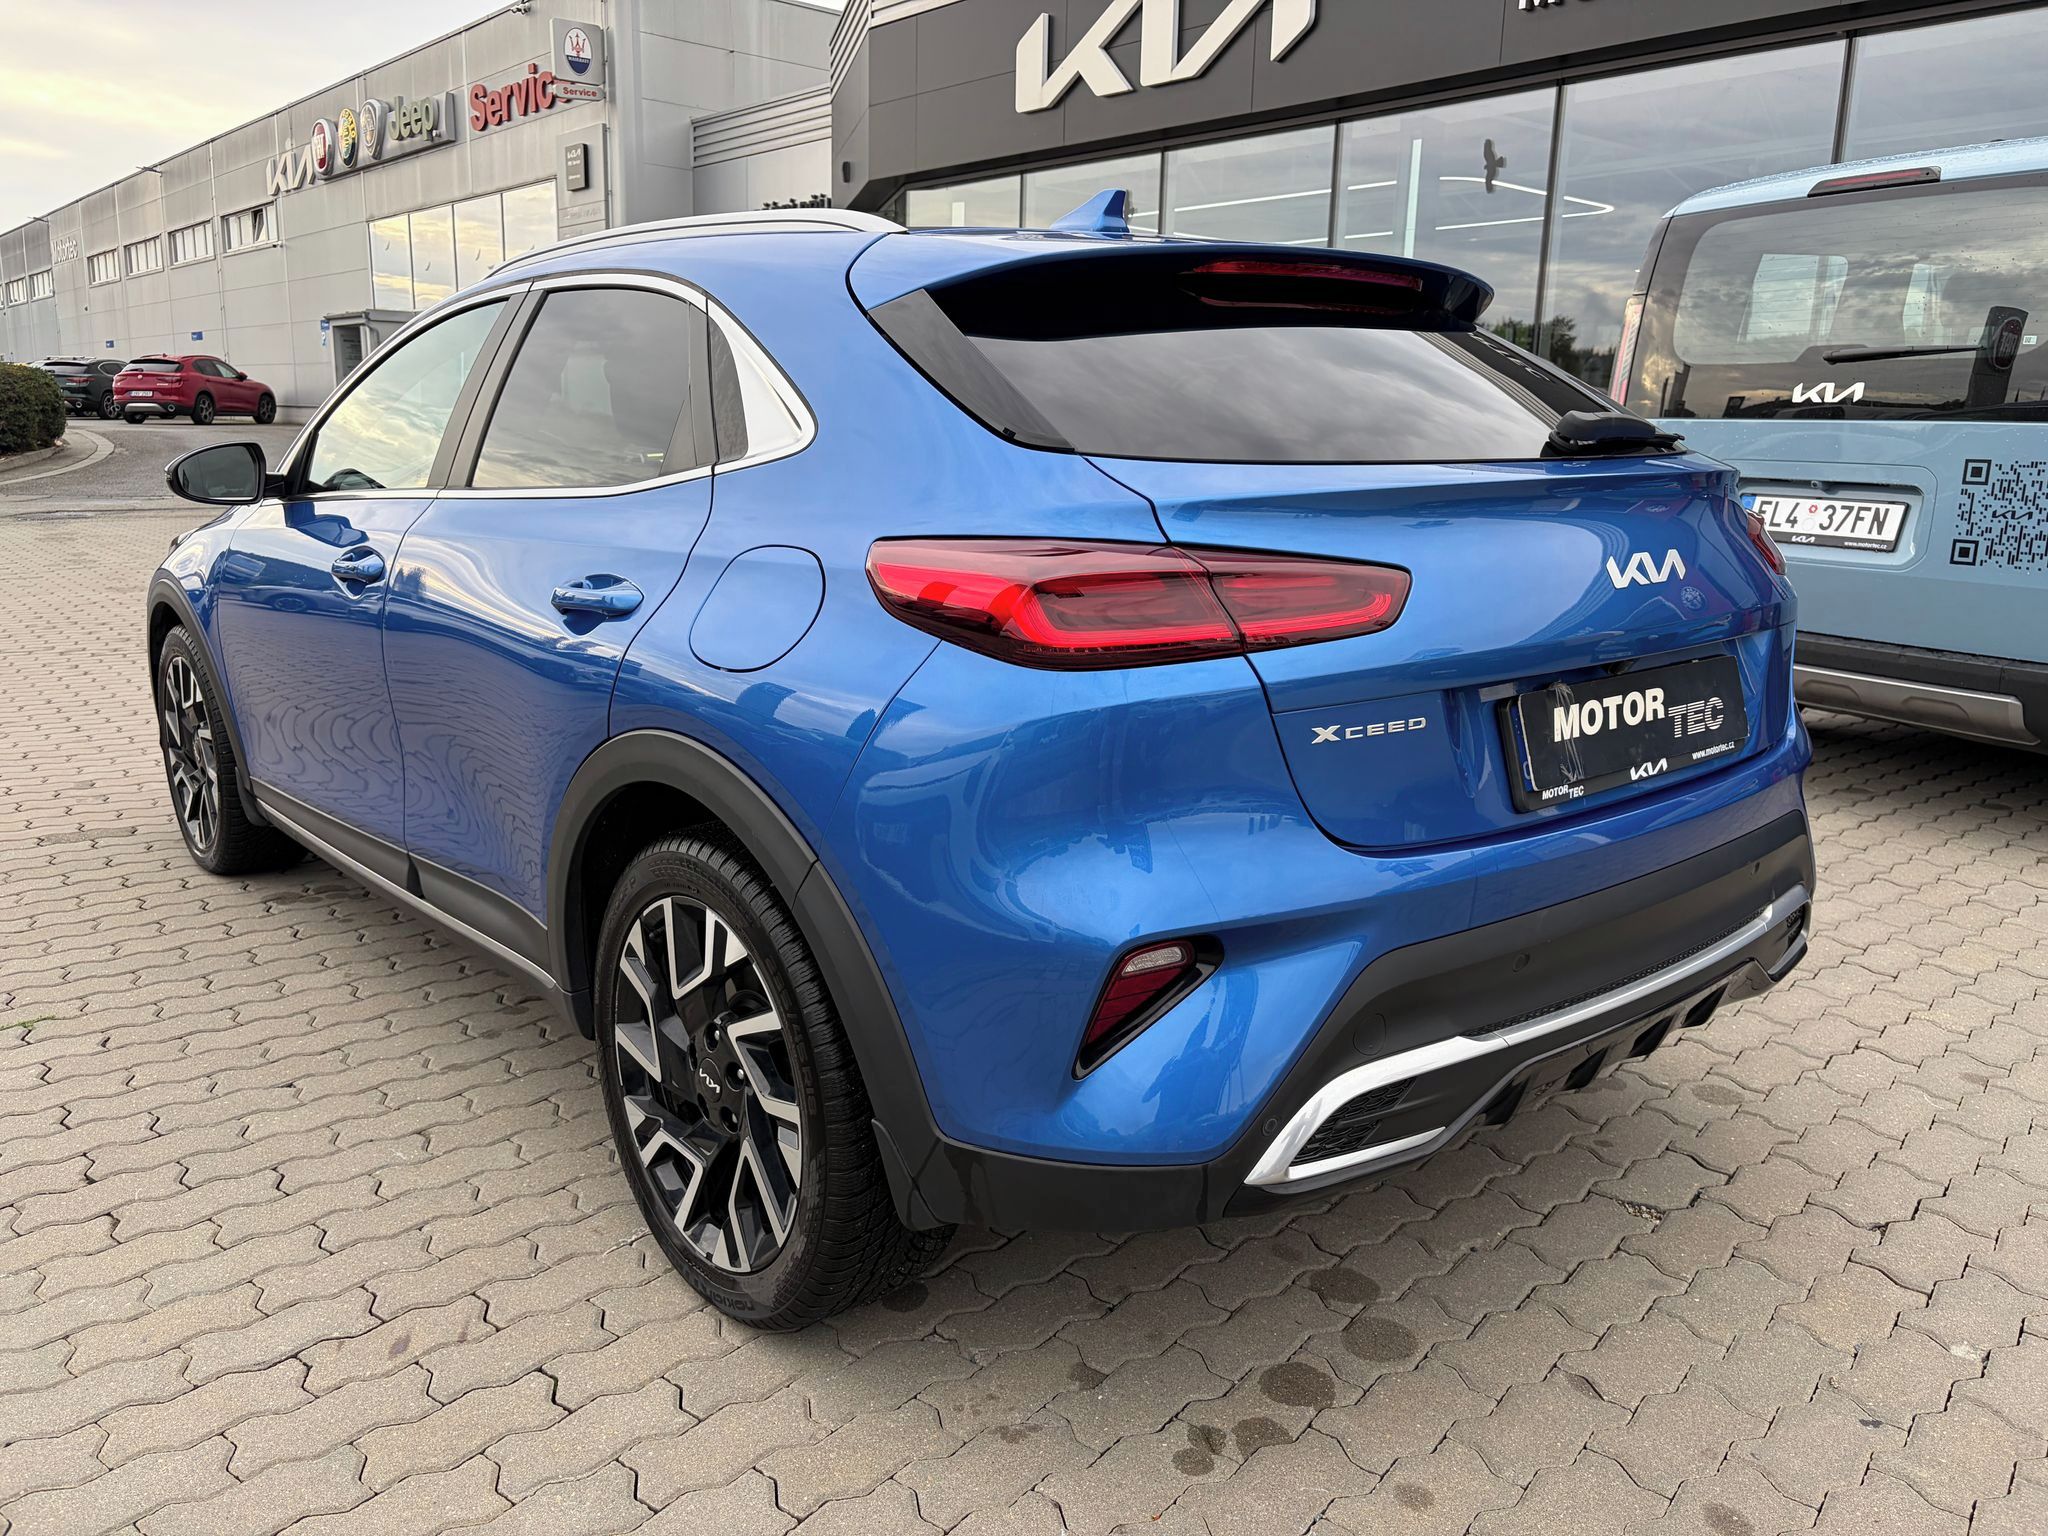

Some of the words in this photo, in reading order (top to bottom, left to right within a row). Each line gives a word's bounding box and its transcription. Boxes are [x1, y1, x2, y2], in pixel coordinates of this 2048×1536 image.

[470, 63, 572, 131] Servic
[562, 86, 598, 97] Service
[387, 95, 435, 141] Jeep
[265, 144, 315, 195] KIA
[1791, 381, 1866, 403] KIA
[1818, 503, 1890, 536] 37FN
[1991, 509, 2034, 521] KIA
[1791, 535, 1816, 543] KIA
[1843, 541, 1888, 550] www.motortec.cz
[1605, 548, 1687, 590] KIA
[1553, 687, 1665, 743] MOTOR
[1668, 696, 1724, 739] TEC
[1311, 716, 1428, 745] XCEED
[1691, 740, 1736, 761] www.motortec.cz
[1629, 757, 1668, 781] KIA
[1542, 784, 1569, 800] MOTOR
[1568, 785, 1585, 799] TEC
